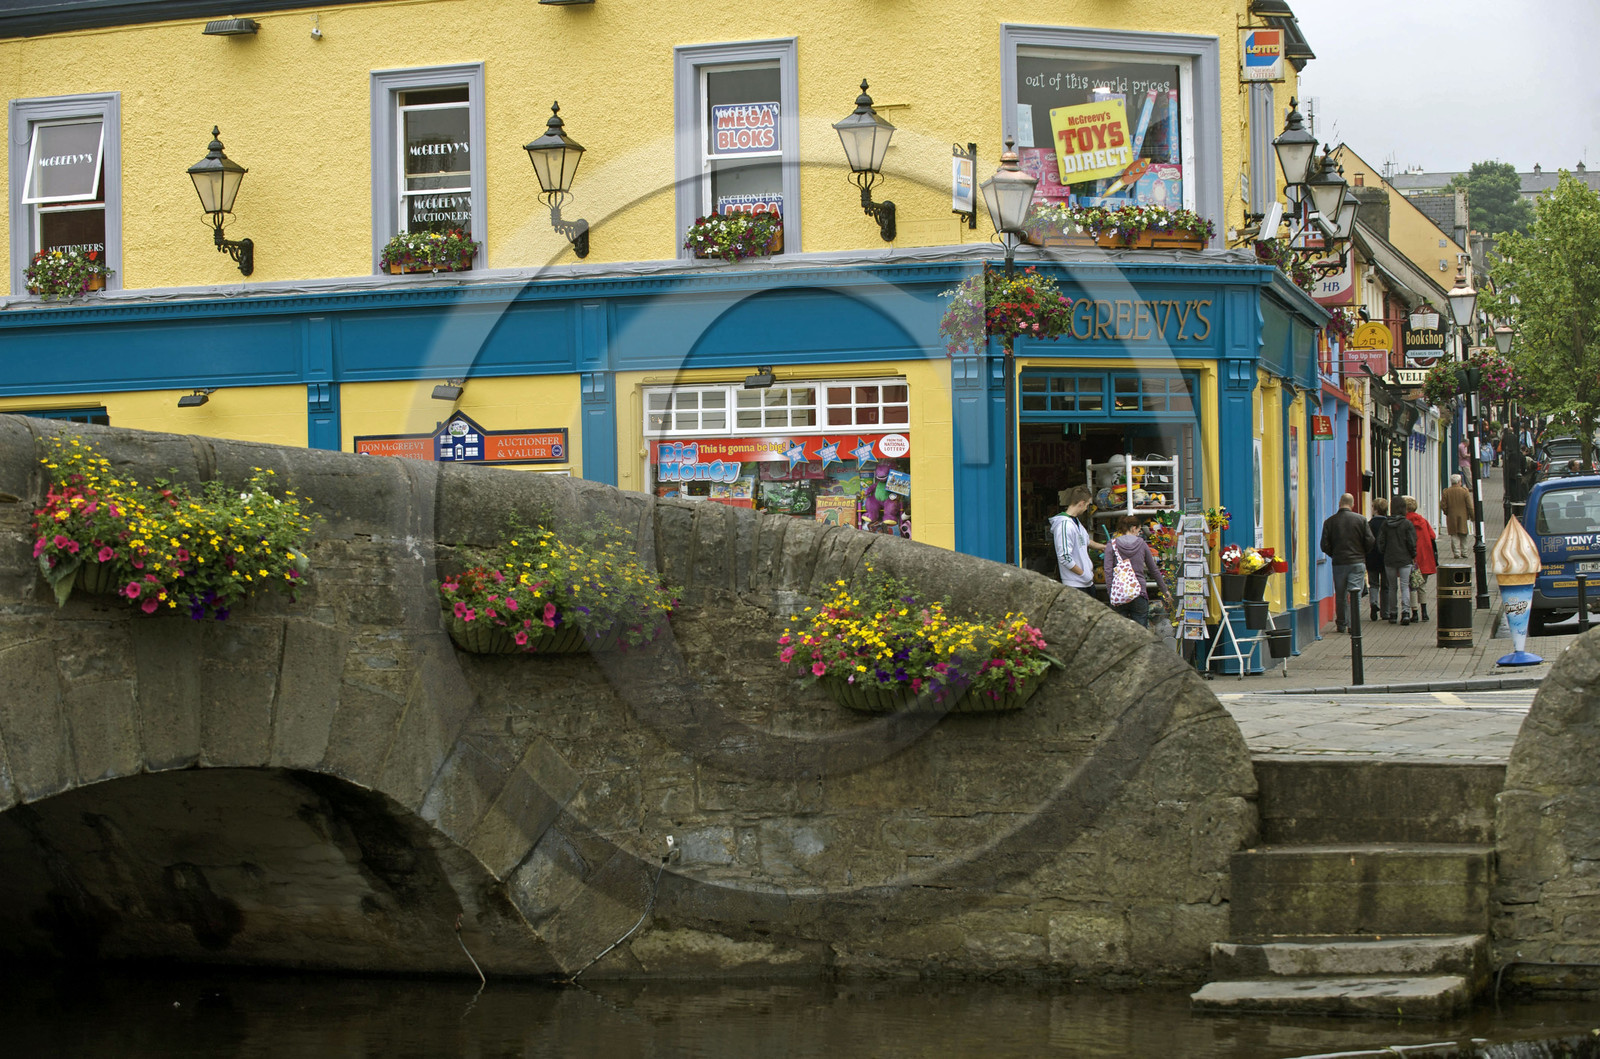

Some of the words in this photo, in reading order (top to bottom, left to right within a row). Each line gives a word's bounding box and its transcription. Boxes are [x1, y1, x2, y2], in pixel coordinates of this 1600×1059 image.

[1246, 44, 1280, 54] LOTTO
[1025, 73, 1046, 87] out
[1049, 73, 1062, 91] of
[1065, 73, 1089, 89] this
[1092, 76, 1128, 92] world
[1132, 80, 1170, 95] prices
[717, 108, 775, 130] MEGA
[1068, 111, 1111, 127] McGreevy's
[717, 128, 775, 149] BLOKS
[1058, 121, 1125, 155] TOYS
[410, 142, 469, 156] McGREEVY'S
[39, 153, 92, 166] McGREEVY'S
[1063, 146, 1129, 174] DIRECT
[719, 192, 784, 204] AUCTIONEERS
[412, 212, 472, 222] AUCTIONEERS
[1323, 281, 1340, 292] HB
[1070, 298, 1213, 341] GREEVY'S
[1405, 329, 1444, 348] Bookshop
[361, 444, 380, 452] DON
[382, 442, 425, 451] McGREEVY
[497, 437, 560, 447] AUCTIONEER
[700, 445, 718, 454] This
[719, 444, 727, 453] is
[728, 445, 755, 456] gonna
[757, 443, 768, 453] be
[769, 442, 787, 454] big!
[497, 450, 505, 458] &
[508, 448, 546, 458] VALUER
[658, 442, 699, 465] Big
[1541, 536, 1565, 553] HP
[1565, 535, 1593, 545] TONY
